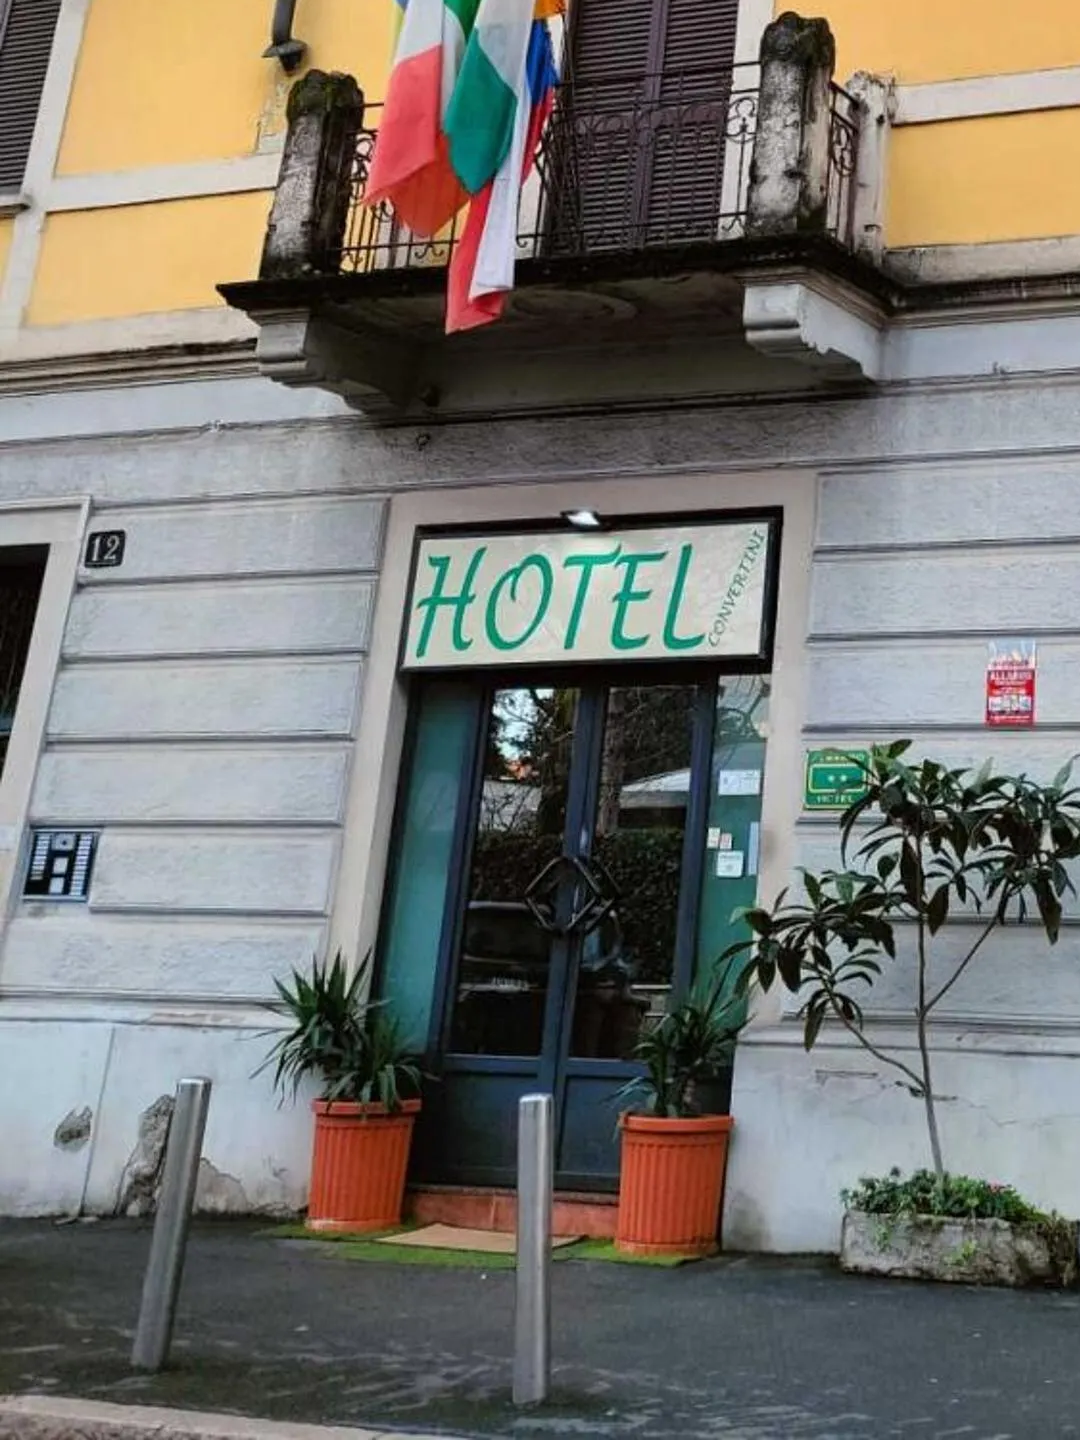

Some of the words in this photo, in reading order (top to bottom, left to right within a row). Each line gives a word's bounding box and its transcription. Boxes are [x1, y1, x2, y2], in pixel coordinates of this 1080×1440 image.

[91, 534, 120, 562] 12
[416, 543, 706, 658] HOTEL
[708, 529, 765, 647] CONVERTINI
